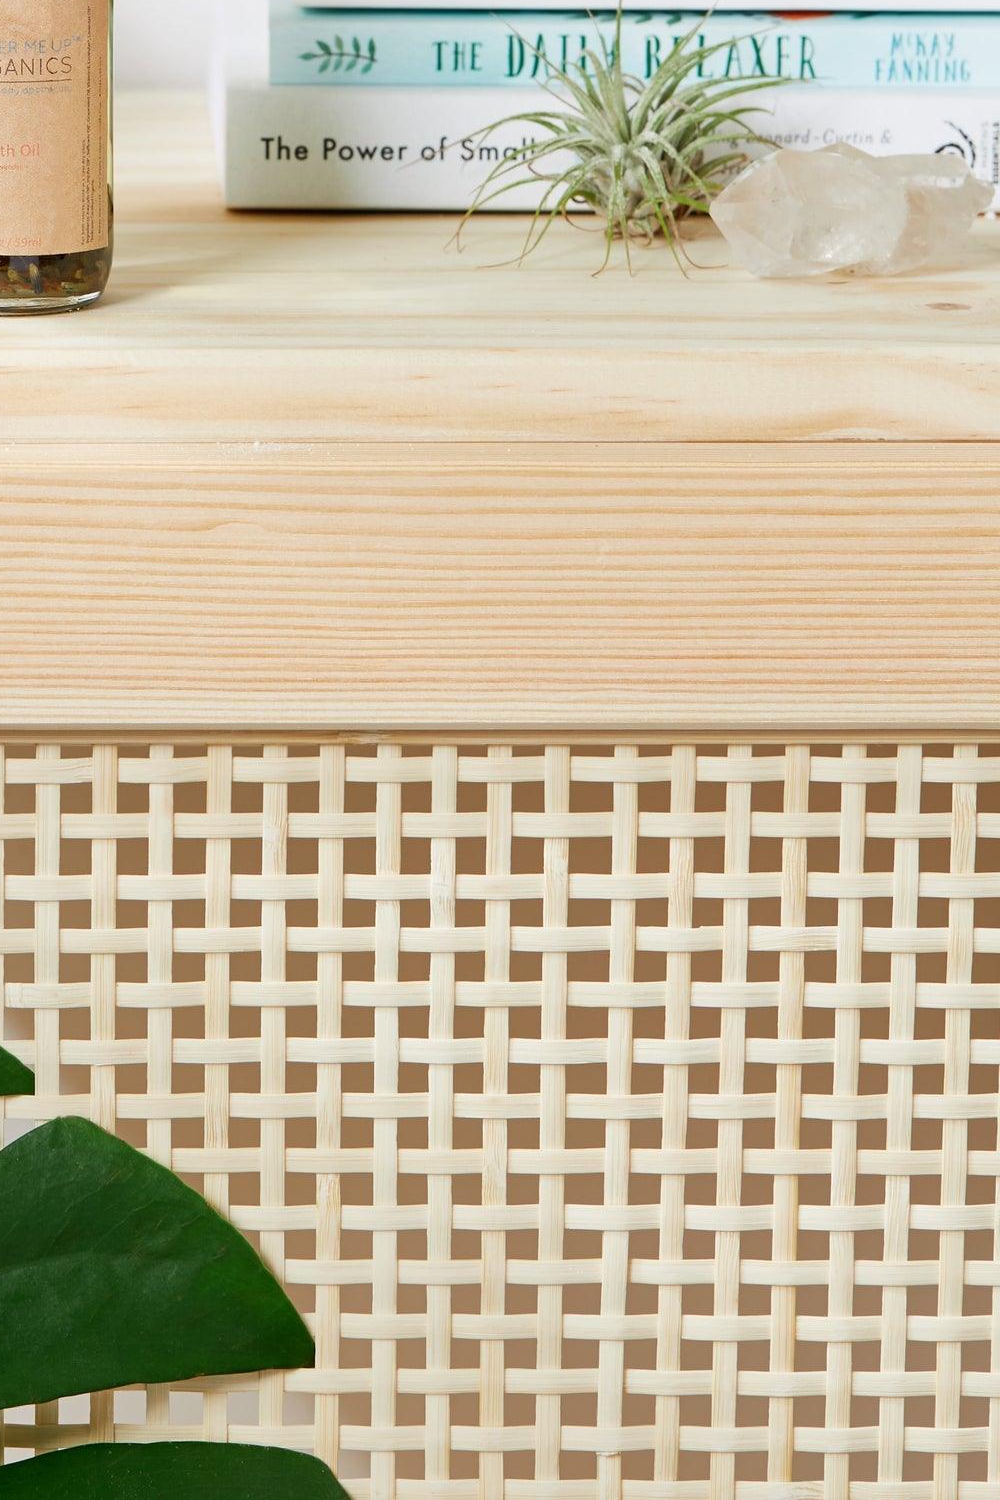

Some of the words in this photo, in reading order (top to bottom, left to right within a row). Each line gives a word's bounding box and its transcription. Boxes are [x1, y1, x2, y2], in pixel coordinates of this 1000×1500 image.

[432, 41, 482, 72] THE
[643, 34, 817, 79] RLAXER
[874, 58, 971, 82] FANNING
[260, 136, 308, 161] The
[322, 137, 408, 161] Power
[420, 136, 447, 161] of
[880, 129, 895, 144] &
[20, 143, 41, 157] Oil
